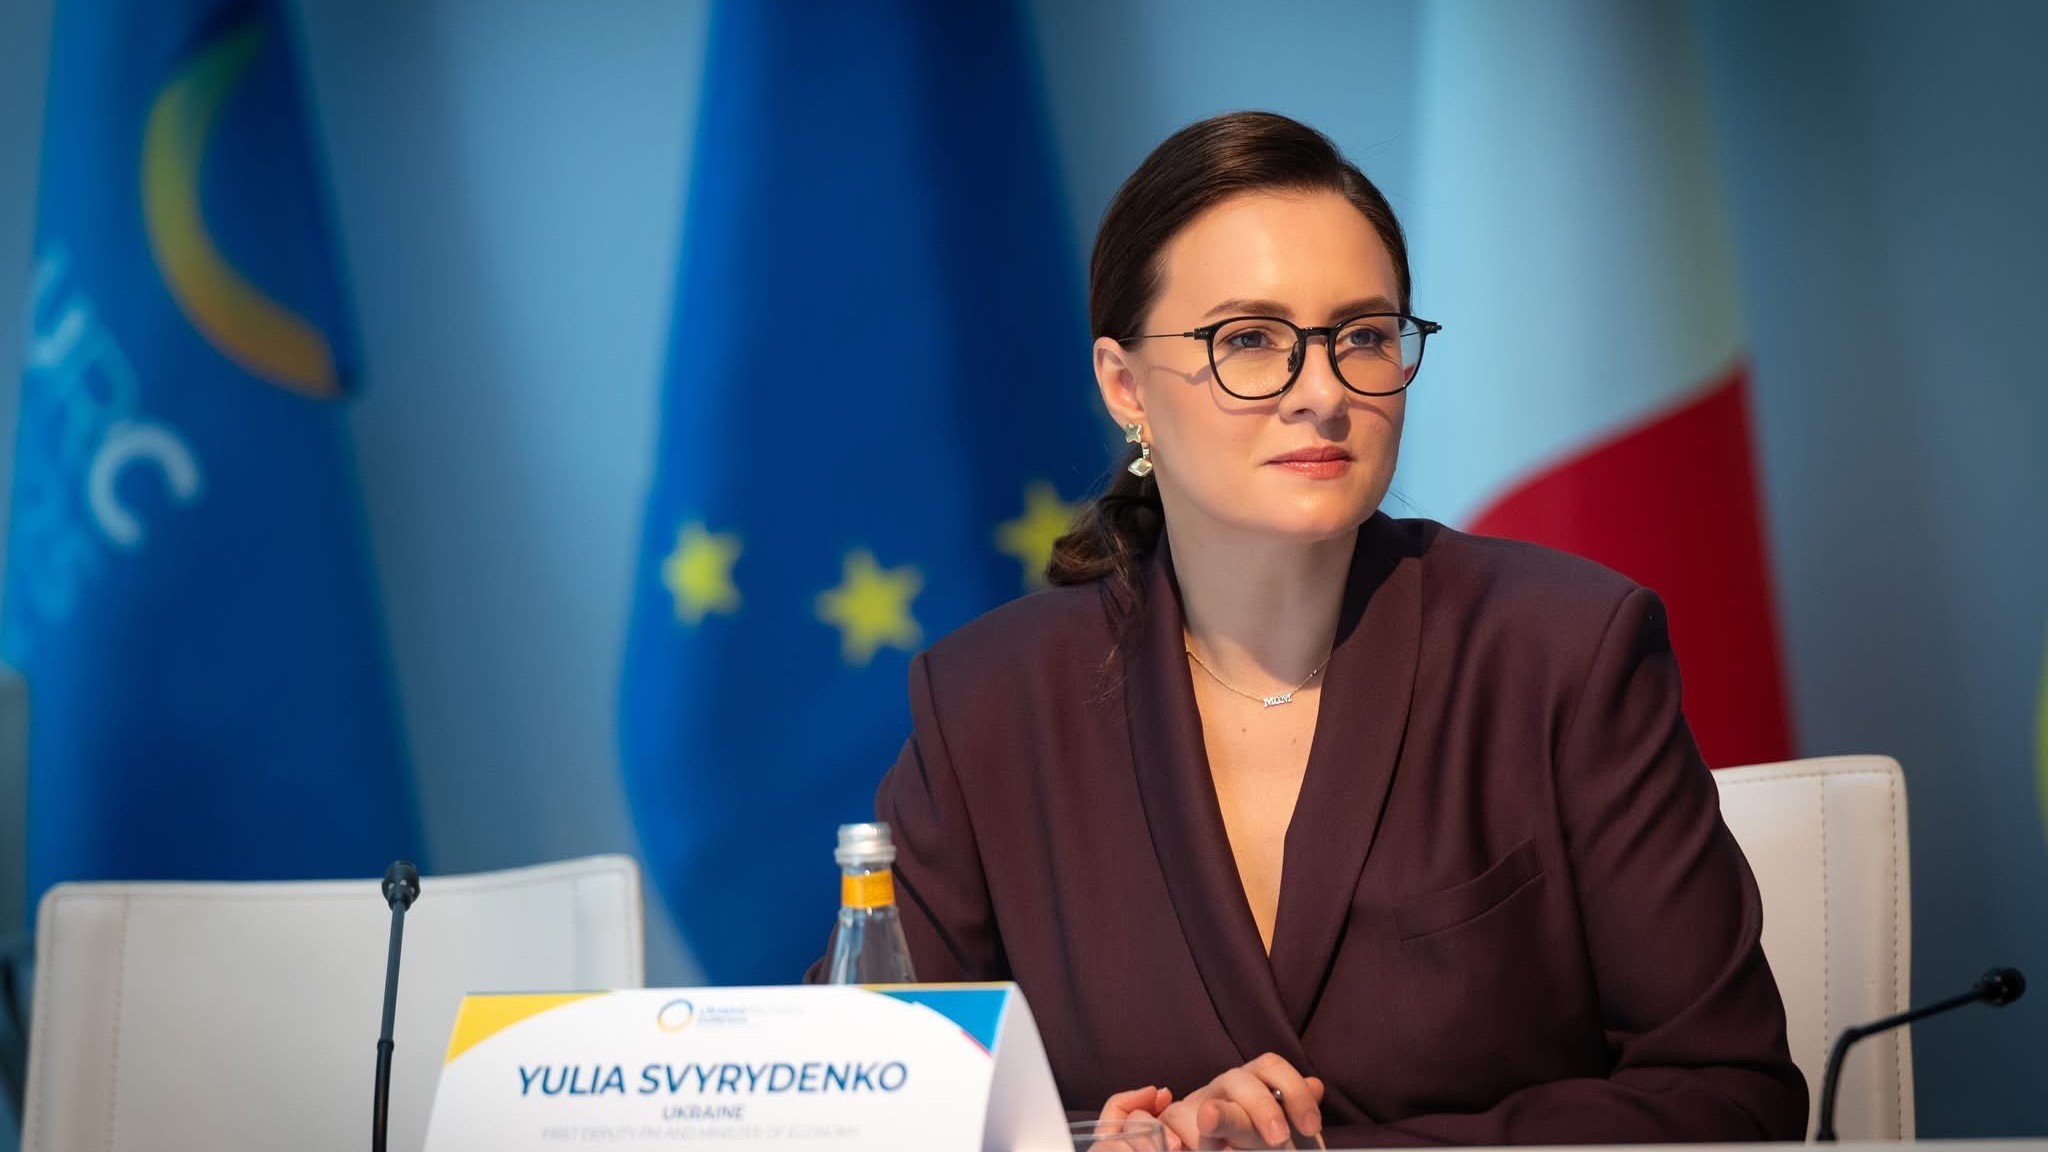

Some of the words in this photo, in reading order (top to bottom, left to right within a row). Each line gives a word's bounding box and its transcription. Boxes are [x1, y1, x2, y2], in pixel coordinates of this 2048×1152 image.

[517, 1063, 627, 1096] YULIA
[637, 1061, 908, 1095] SVYRYDENKO
[661, 1104, 745, 1122] UKRAINE
